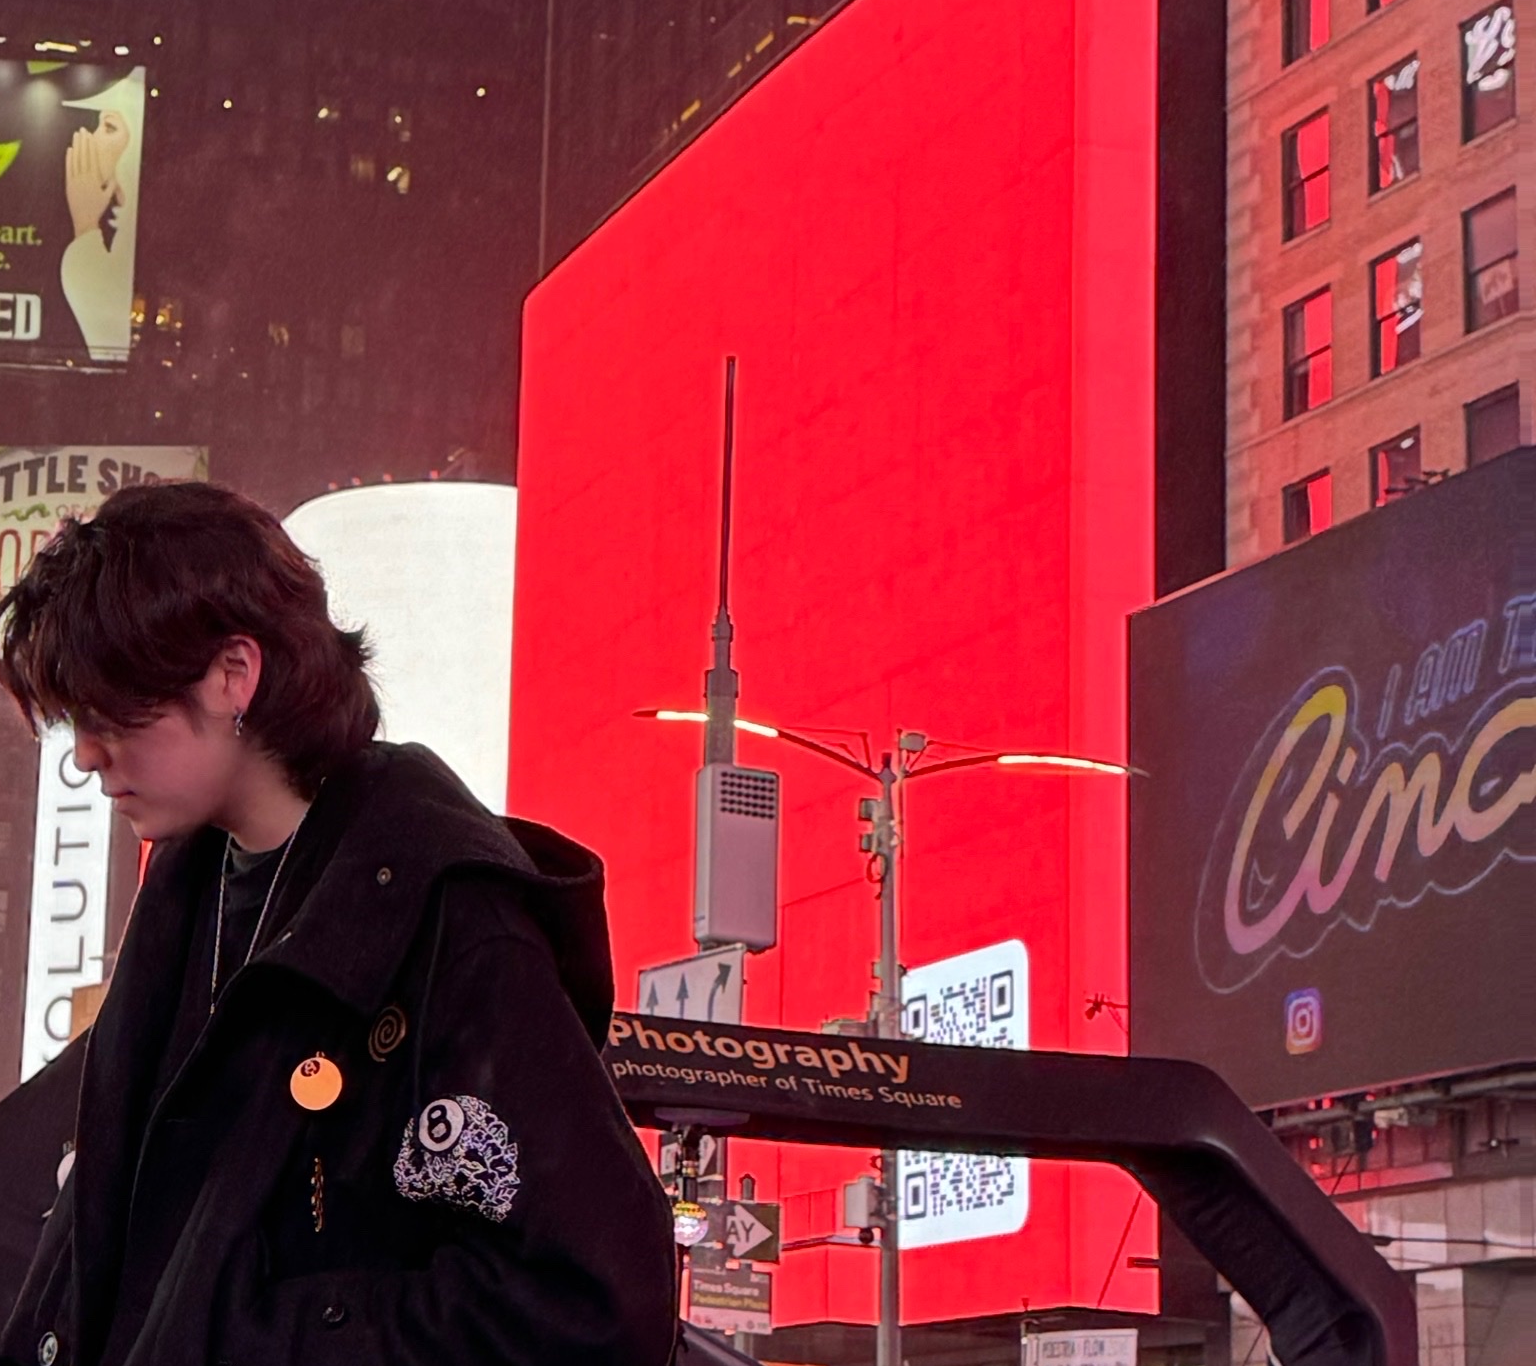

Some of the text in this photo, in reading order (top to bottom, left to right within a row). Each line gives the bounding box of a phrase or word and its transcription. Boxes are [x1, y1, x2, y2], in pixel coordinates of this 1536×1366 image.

[1404, 643, 1487, 725] AM
[42, 749, 93, 1064] OLUTIO
[609, 1019, 910, 1083] Photography
[612, 1061, 962, 1109] photographer of Times Square
[694, 1279, 760, 1297] Times Square
